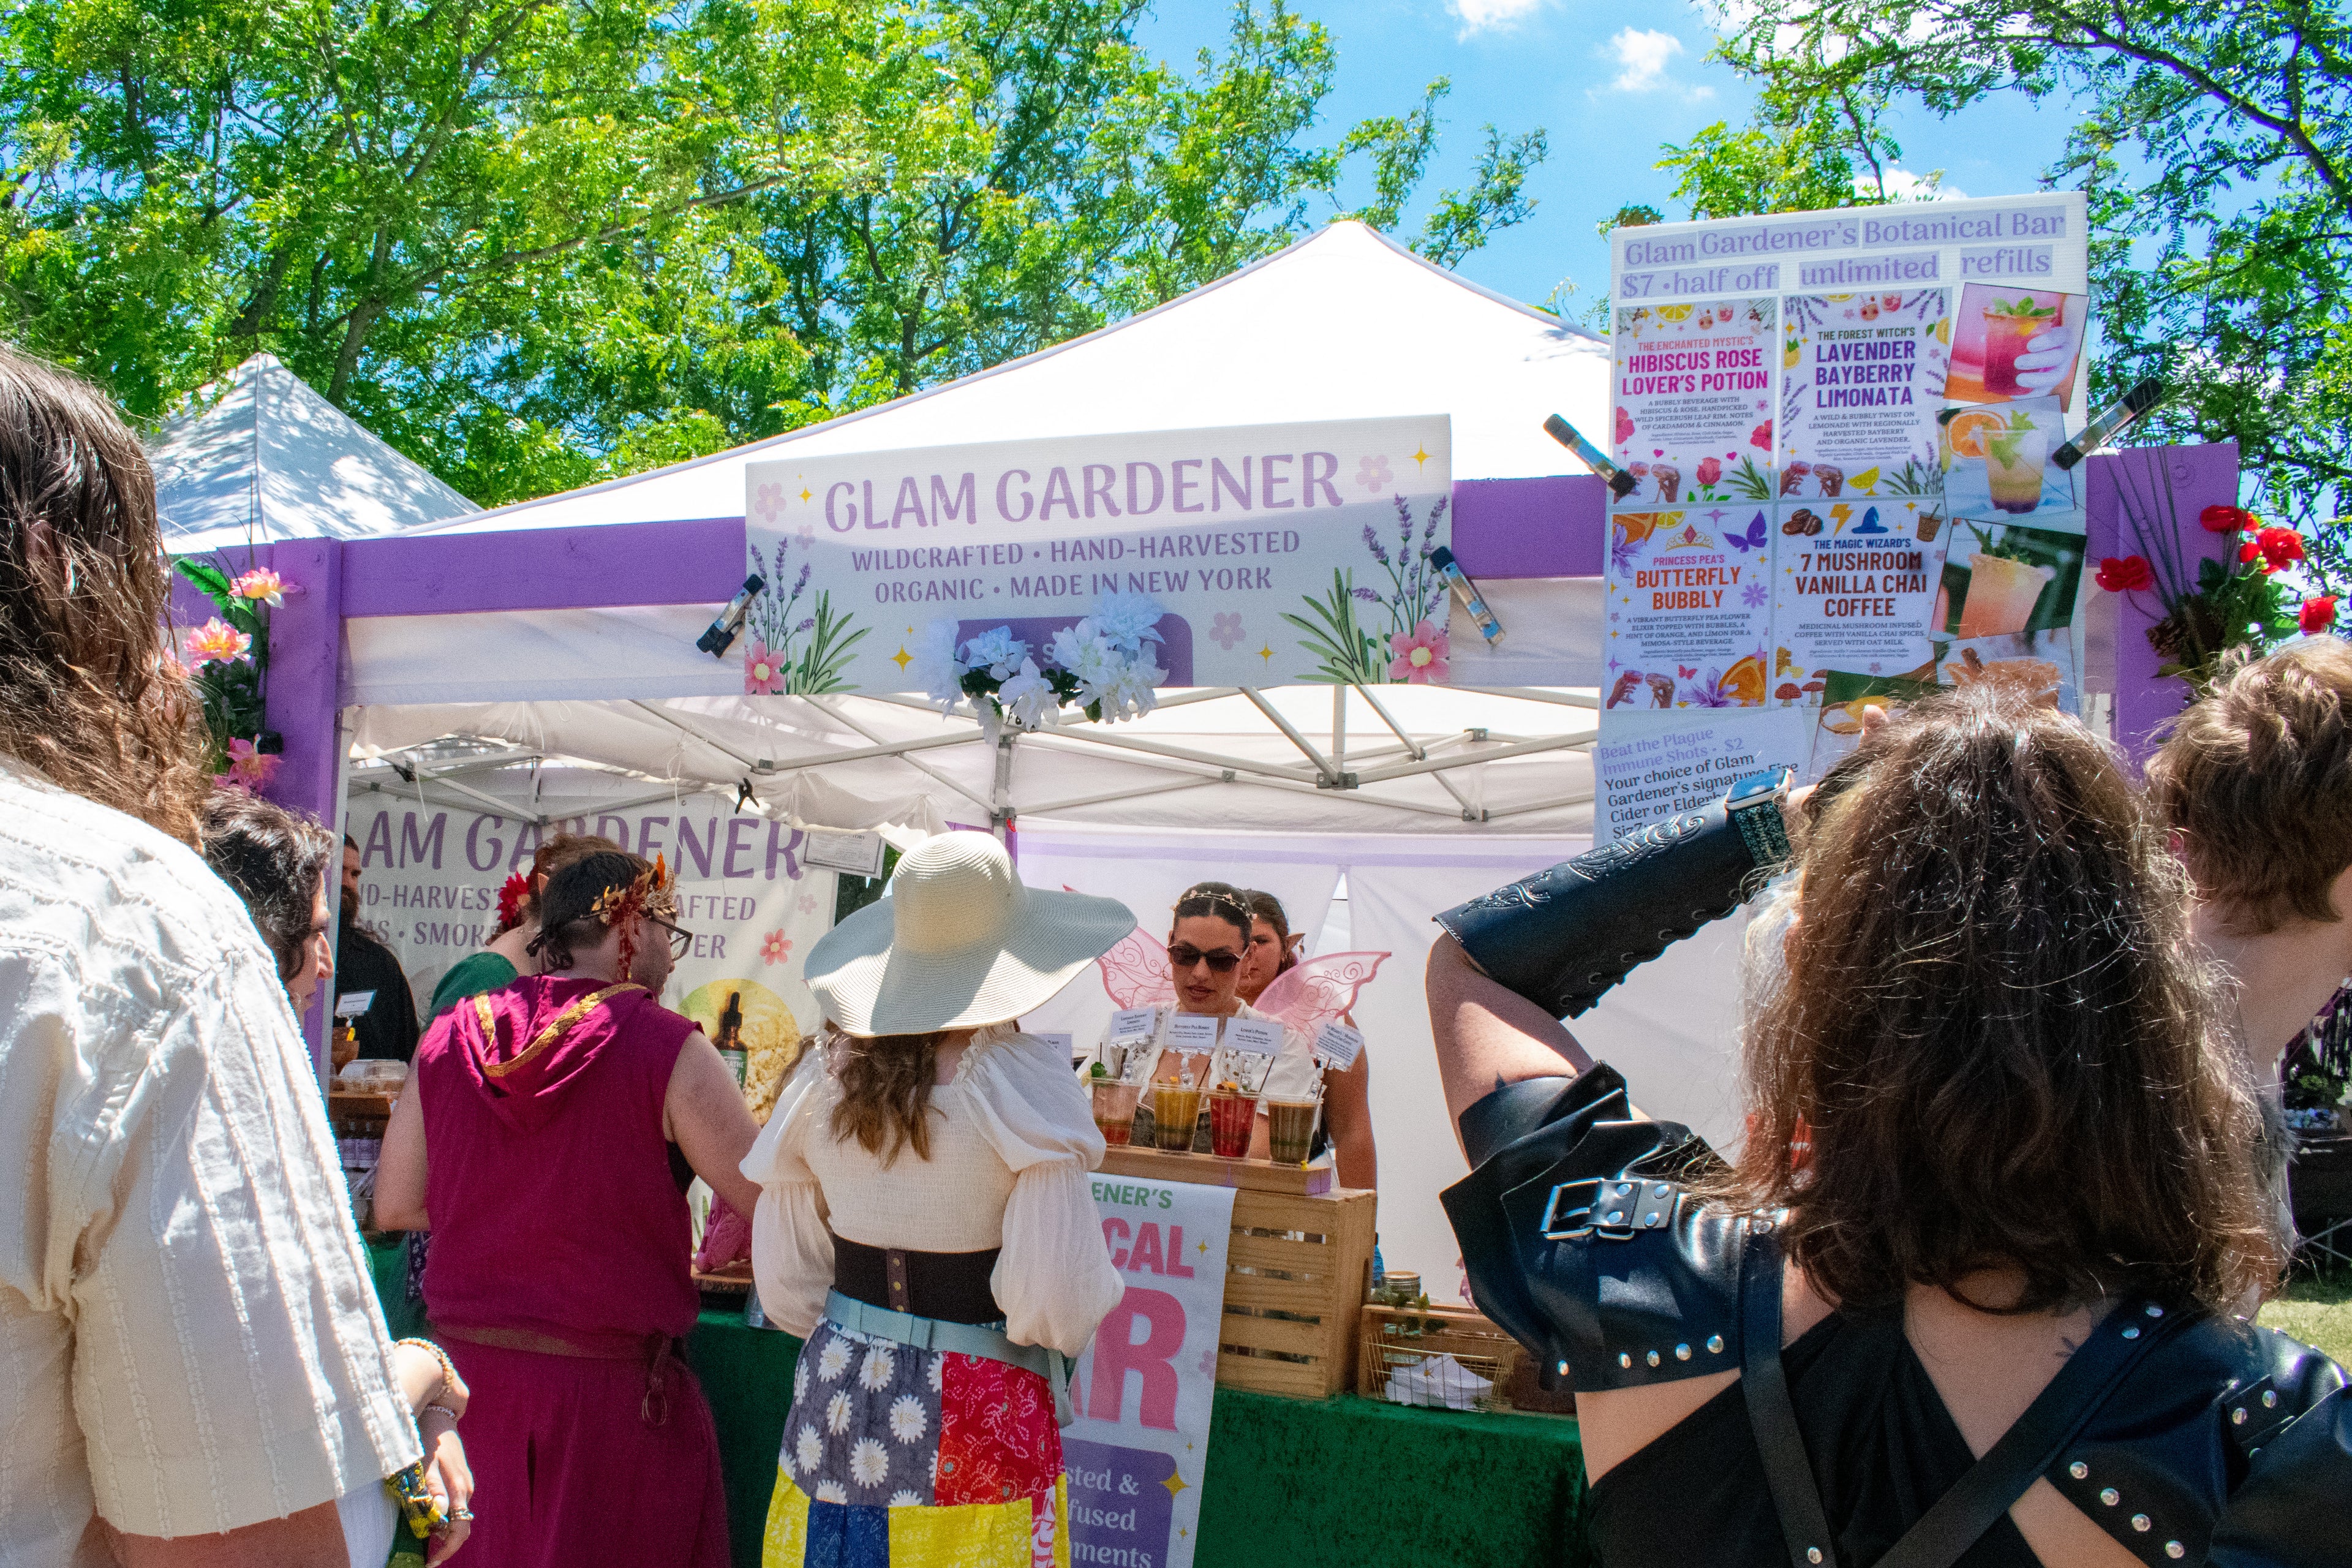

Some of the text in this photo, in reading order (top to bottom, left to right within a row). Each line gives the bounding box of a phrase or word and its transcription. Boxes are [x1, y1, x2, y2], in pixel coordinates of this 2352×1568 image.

[1626, 213, 2065, 265] Glam Gardener's Botanical Bar
[1623, 273, 1654, 297] $7
[1736, 265, 1779, 291] off
[1800, 254, 1937, 286] unlimited
[1962, 249, 2050, 274] refills
[1638, 336, 1754, 352] THE ENCHANTED MYSTIC'S
[1818, 327, 1915, 341] THE FOREST WITCH'S
[1629, 348, 1762, 373] HIBISCUS ROSE
[1816, 340, 1916, 363] LAVENDER
[1622, 370, 1768, 395] LOVER'S POTION
[1815, 363, 1915, 385] BAYBERRY
[1817, 386, 1913, 409] LIMONATA
[824, 451, 1344, 534] GLAM GARDENER
[851, 529, 1301, 572] WILDCRAFTED HAND-HARVESTED
[1814, 538, 1911, 549] THE MAGIC WIZARD'S
[1654, 554, 1725, 566] PRINCESS PEA'S
[1800, 551, 1923, 572] 7 MUSHROOM
[874, 567, 1273, 604] ORGANIC MADE IN NEW YORK
[1636, 566, 1741, 589] BUTTERFLY
[1795, 574, 1927, 594] VANILLA CHAI
[1653, 589, 1723, 610] BUBBLY
[1824, 598, 1896, 617] COFFEE
[1600, 728, 1713, 760] Beat the Plague
[1603, 737, 1744, 775] Immune Shots $2
[1604, 775, 1640, 791] Your
[1644, 764, 1692, 784] choice
[1695, 760, 1712, 774] of
[1714, 754, 1755, 770] Glam
[1608, 780, 1689, 807] Gardener's
[1610, 807, 1650, 823] Cider
[1654, 804, 1670, 815] or
[345, 810, 448, 870] AM
[1071, 1286, 1186, 1432] R
[1118, 1474, 1139, 1496] &
[1069, 1541, 1152, 1568] ments
